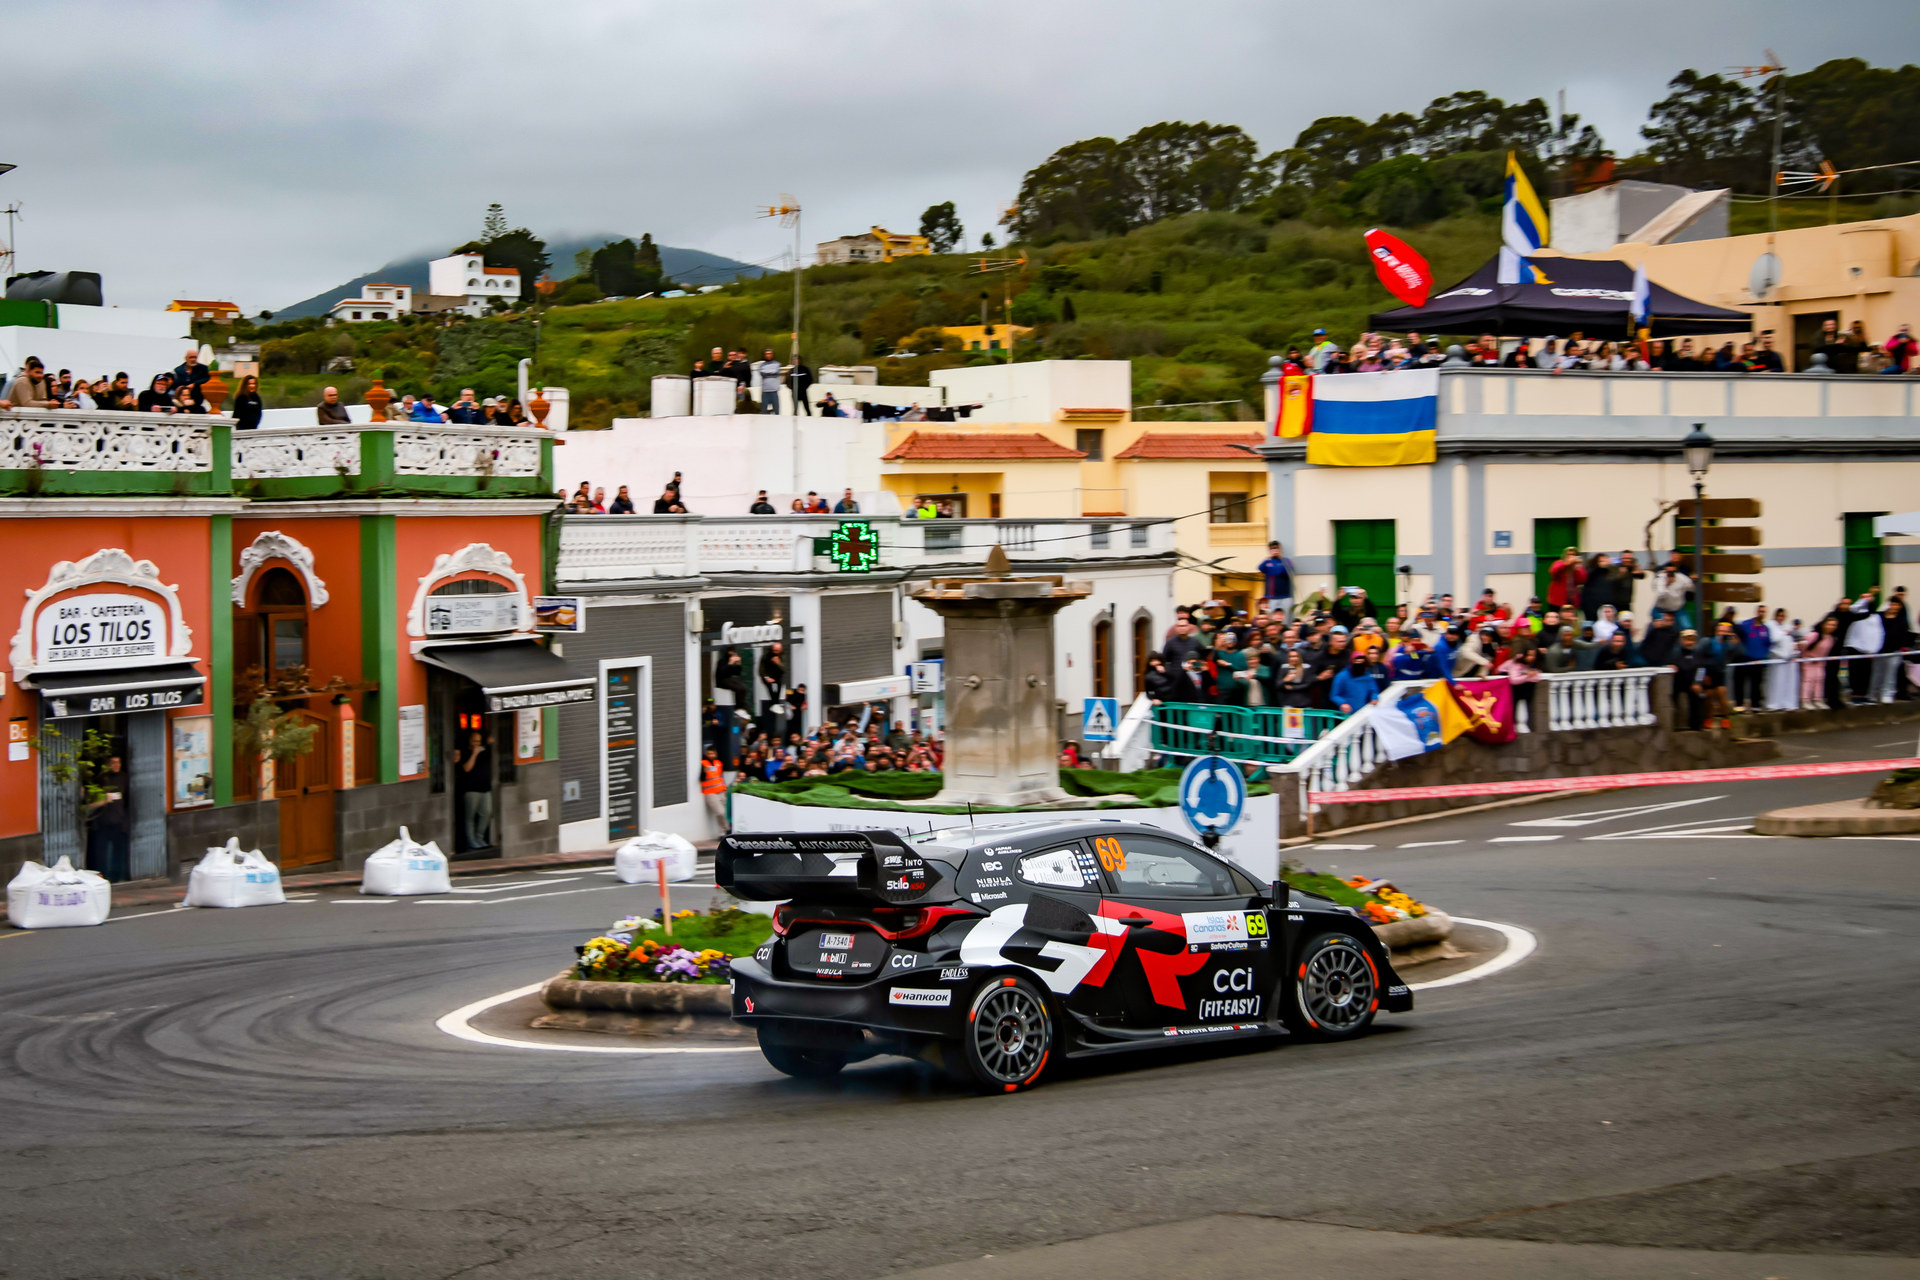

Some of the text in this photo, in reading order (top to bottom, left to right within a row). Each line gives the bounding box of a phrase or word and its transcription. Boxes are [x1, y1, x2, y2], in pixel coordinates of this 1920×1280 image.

[60, 607, 80, 619] BAR
[91, 602, 144, 618] CAFETERÍA
[53, 620, 151, 645] LOS TILOS
[63, 649, 78, 658] BAR
[81, 648, 92, 657] DE
[94, 647, 109, 656] LOS
[112, 646, 121, 655] DE
[124, 644, 156, 654] SIEMPRE
[90, 691, 183, 712] BAR LOS TILOS
[726, 837, 872, 850] Panasonic AUTOMOTIVE
[1095, 837, 1127, 872] 69
[887, 876, 909, 890] Stilo
[981, 891, 1008, 900] Microsoft
[1246, 914, 1267, 936] 69
[940, 968, 969, 978] ENDLESS
